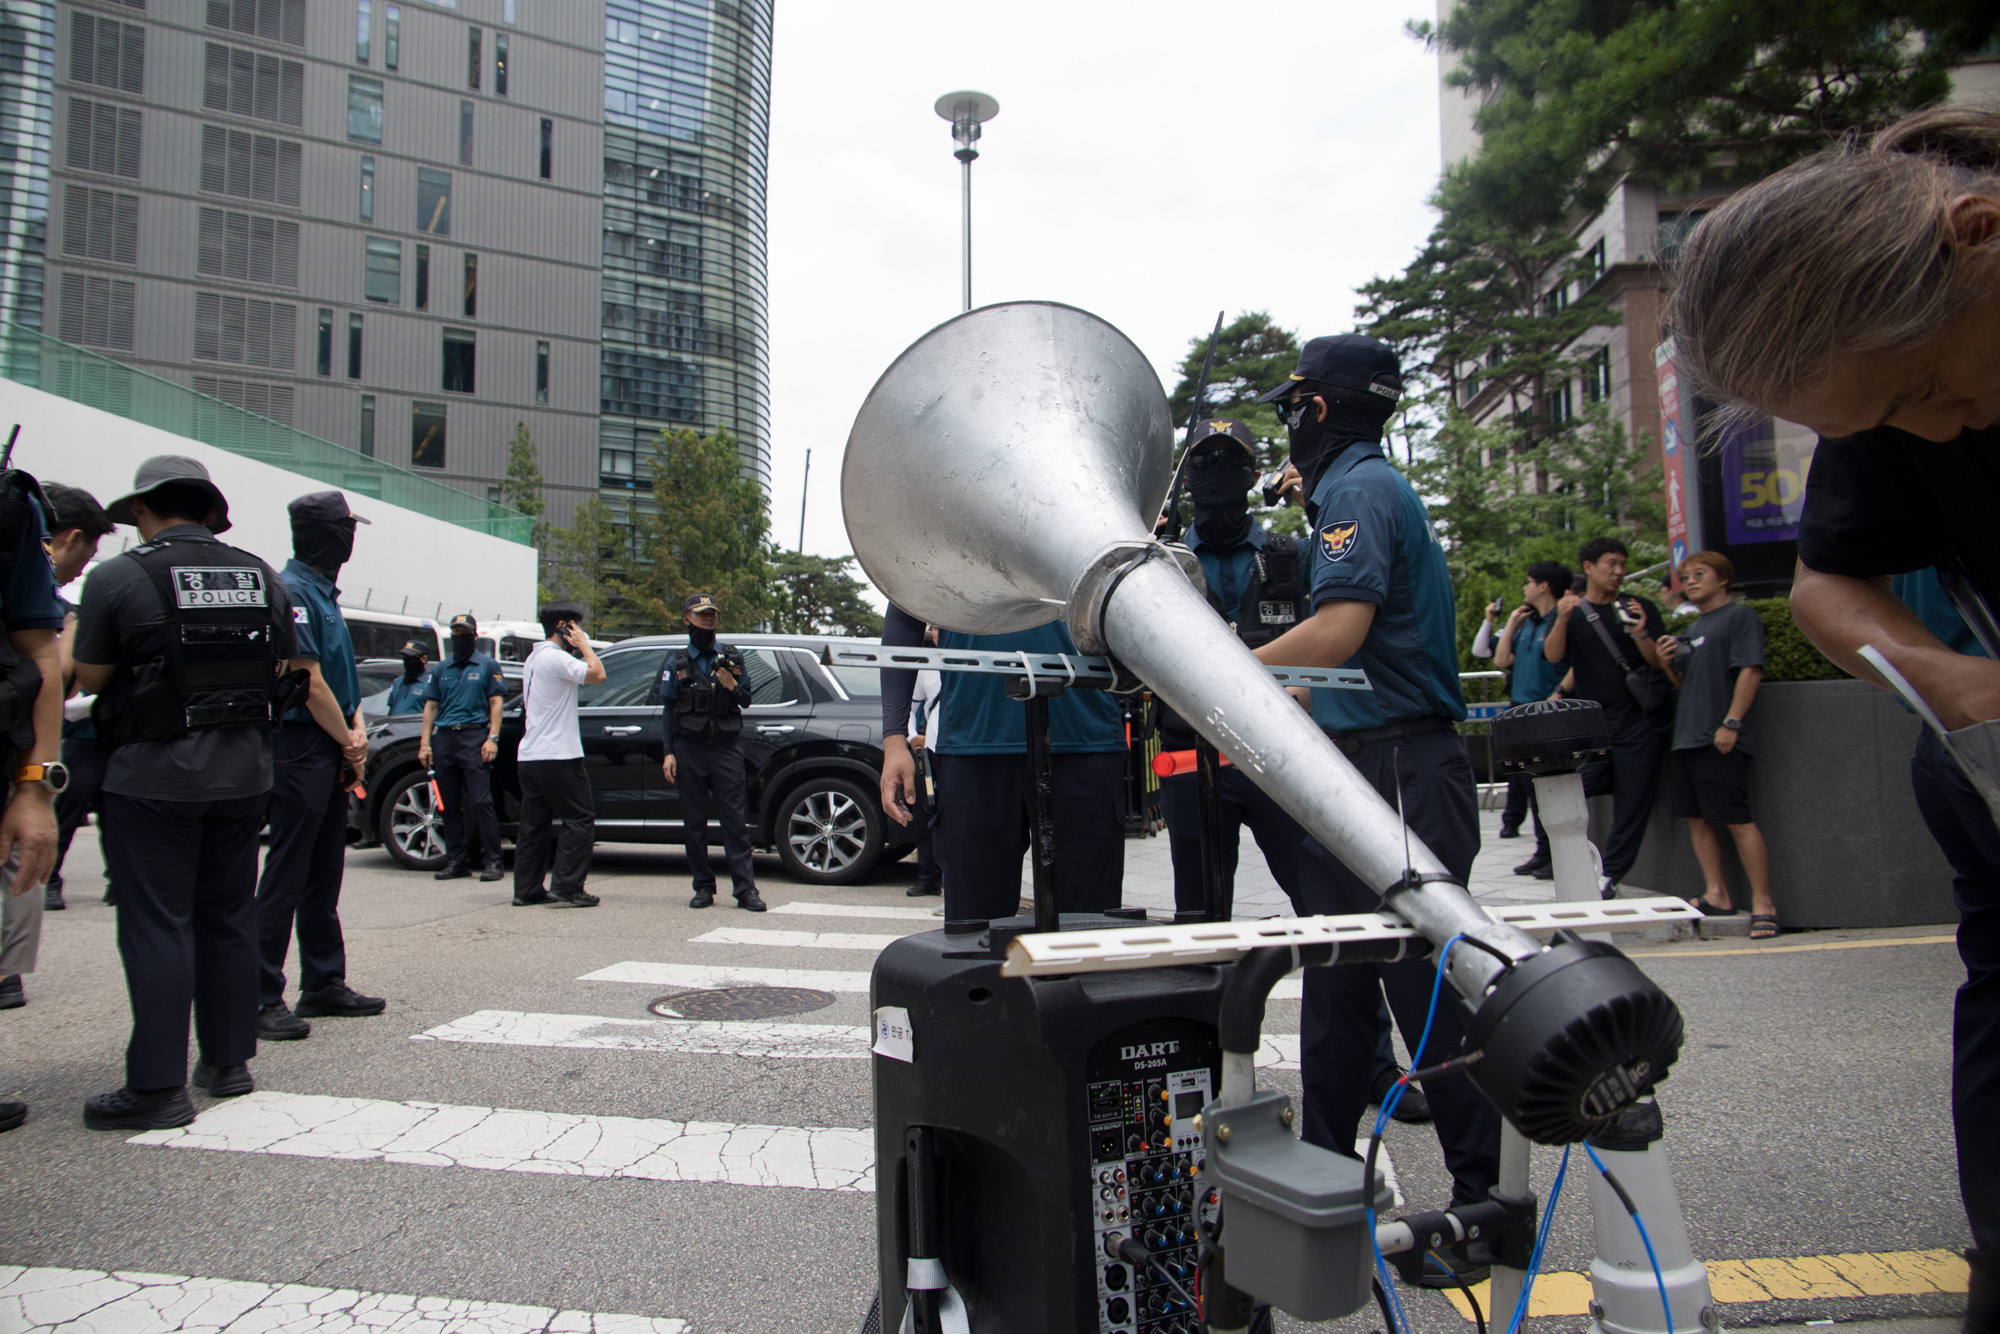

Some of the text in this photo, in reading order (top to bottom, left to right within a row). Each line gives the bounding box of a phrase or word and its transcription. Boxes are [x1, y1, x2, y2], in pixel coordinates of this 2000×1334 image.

[188, 592, 257, 603] POLICE
[1120, 1040, 1180, 1060] DART
[1134, 1058, 1168, 1070] DS-205A
